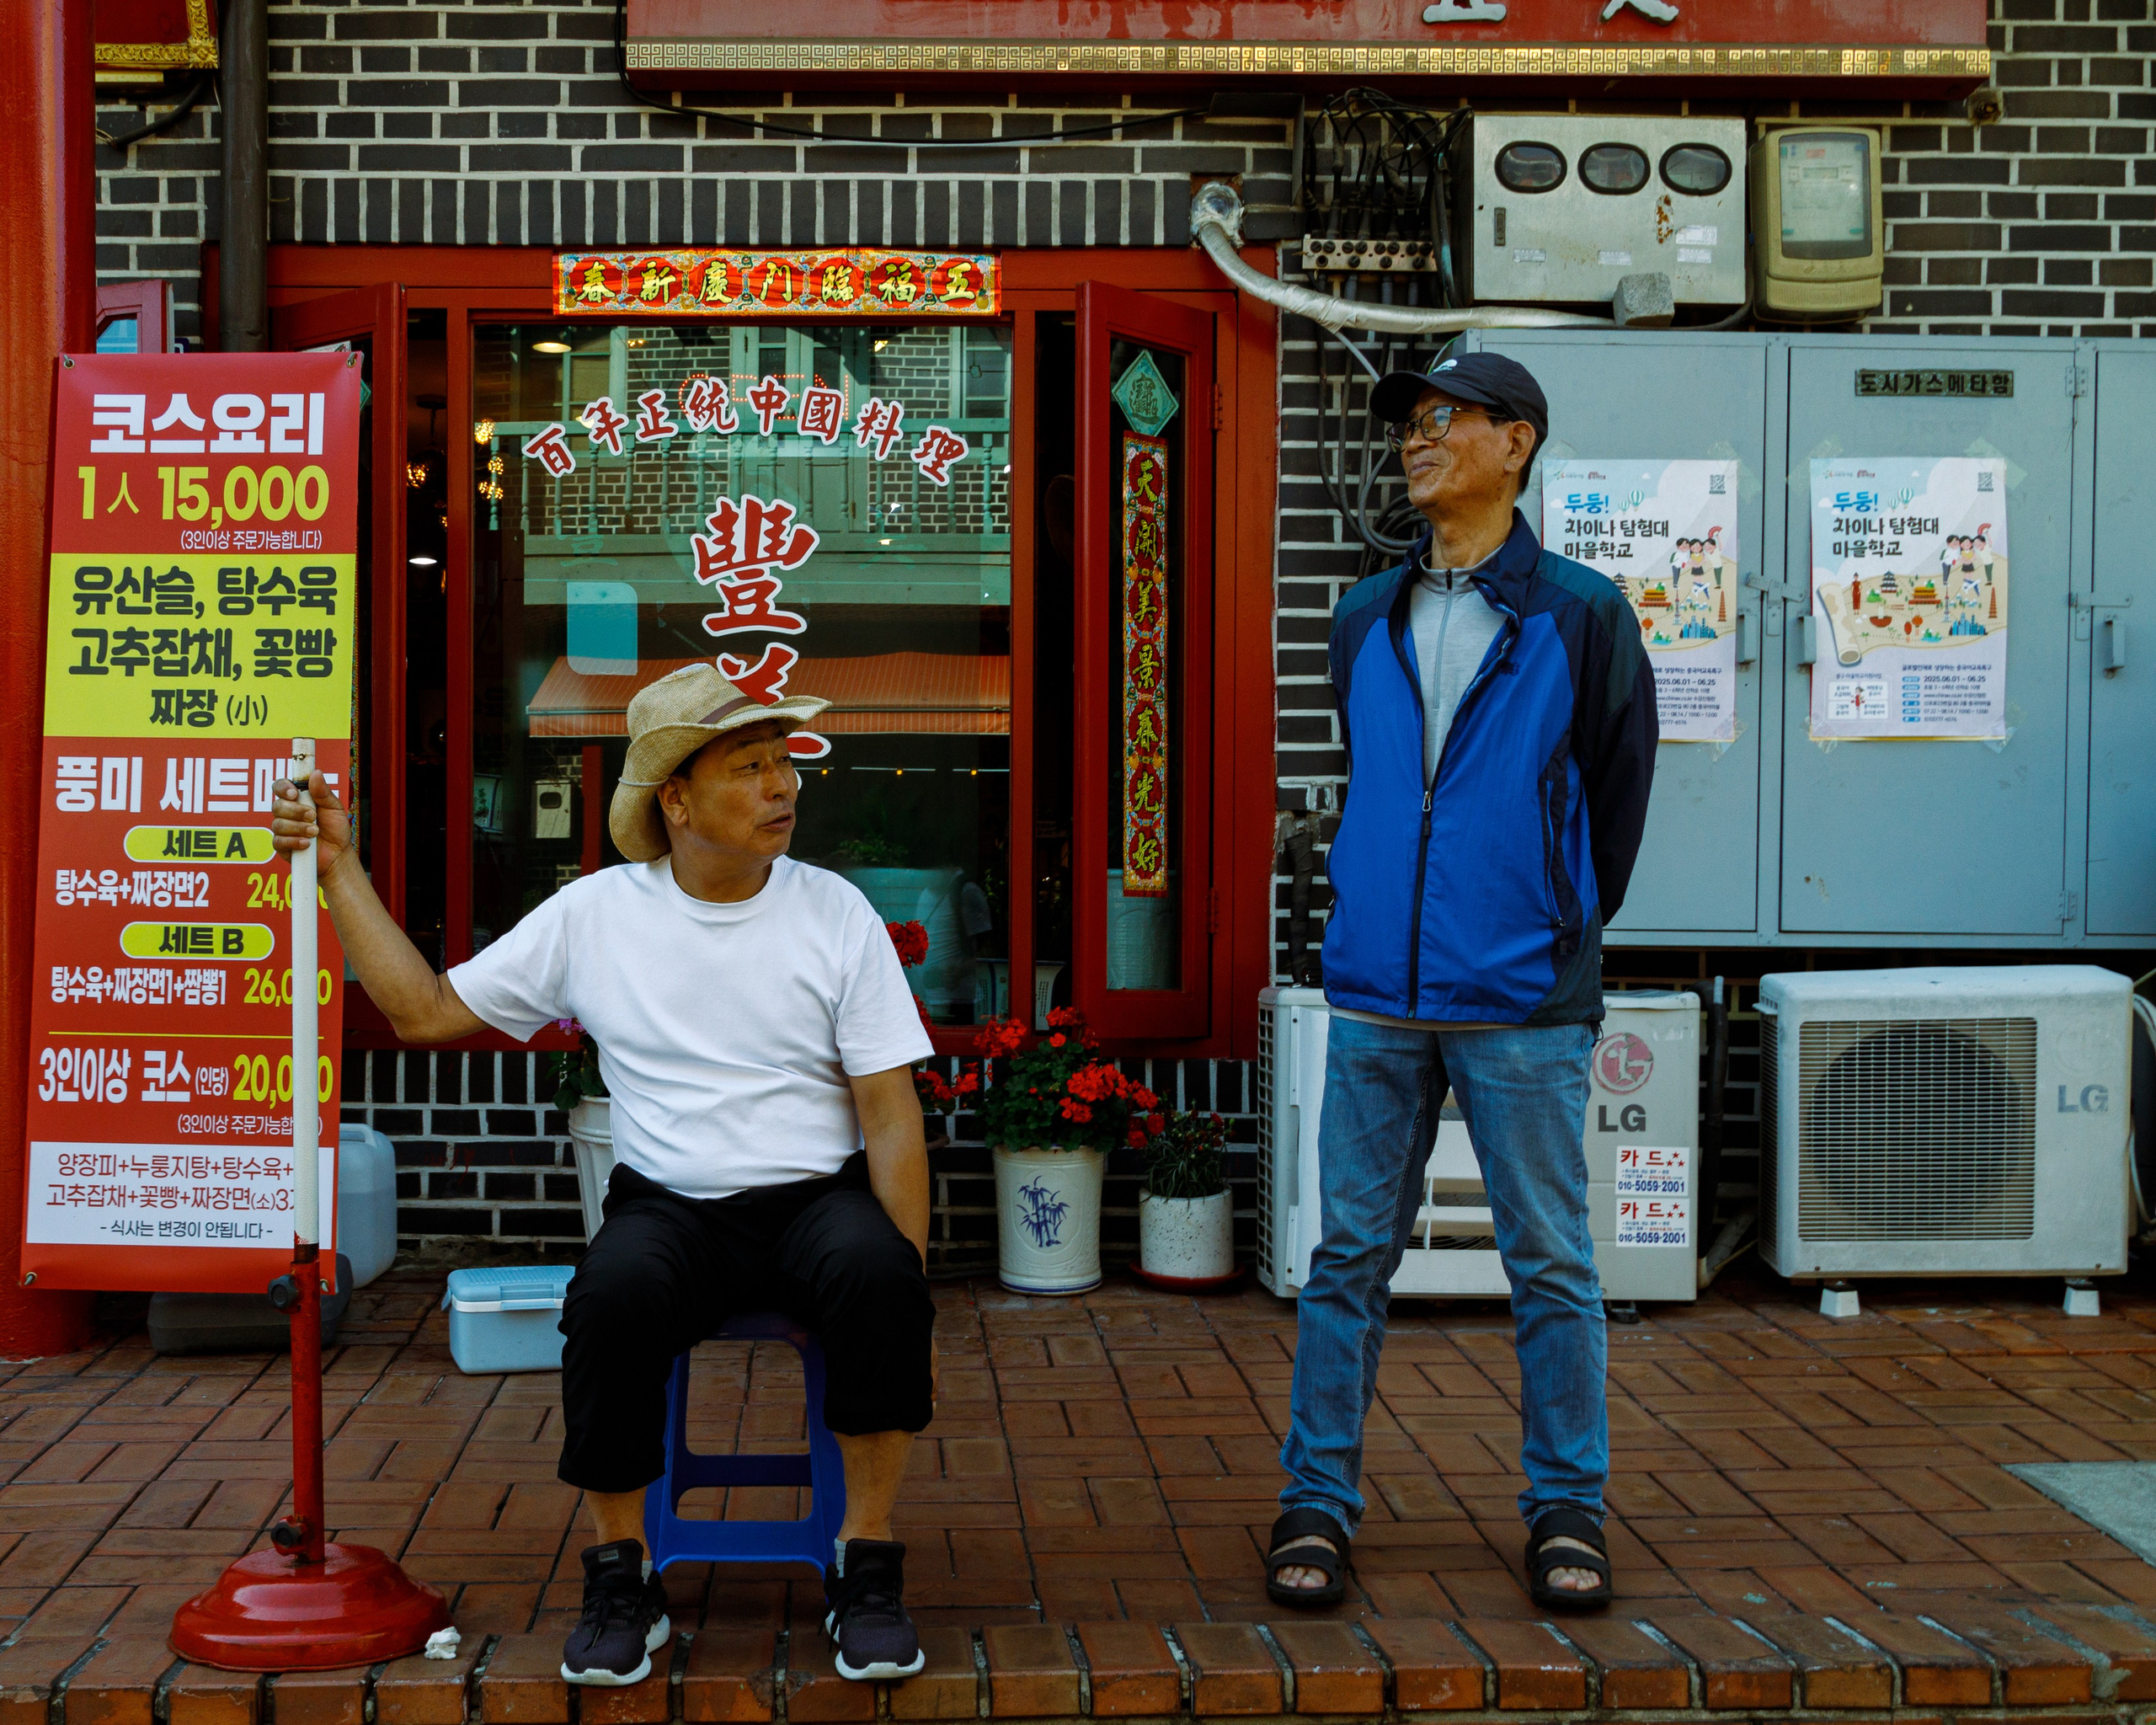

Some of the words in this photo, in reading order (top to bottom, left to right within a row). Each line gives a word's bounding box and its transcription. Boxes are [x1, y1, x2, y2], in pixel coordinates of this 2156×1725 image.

[1860, 373, 2009, 394] 도시가스메타함
[89, 393, 325, 456] 코스요리
[157, 465, 329, 530] 15,000
[1564, 493, 1609, 514] 두둥!
[1833, 490, 1878, 512] 두둥!
[1564, 518, 1615, 537] 차이나
[1620, 518, 1669, 537] 탐험대
[1833, 517, 1884, 536] 차이나
[1889, 516, 1940, 535] 탐험대
[180, 530, 229, 550] (3인이상
[232, 530, 322, 550] 주문가능합니다)
[1564, 542, 1634, 559] 마을학교
[1833, 539, 1903, 558] 마을학교
[72, 565, 205, 619] 유산슬,
[218, 565, 337, 616] 탕수육
[68, 627, 242, 681] 고추잡채,
[253, 628, 337, 678] 꽃빵
[150, 689, 217, 727] 짜장
[226, 694, 268, 726] (小)
[56, 756, 142, 813] 풍미
[159, 757, 339, 814] 세트메
[163, 830, 217, 858] 세트
[225, 832, 247, 858] A
[56, 869, 209, 908] 탕수육+짜장면2
[158, 926, 214, 955] 세트
[222, 927, 244, 954] B
[243, 968, 333, 1007] 26,00
[38, 1048, 131, 1103] 3인이상
[232, 1054, 334, 1109] 20,00
[2057, 1084, 2109, 1113] LG
[178, 1114, 228, 1135] (3인이상
[231, 1114, 323, 1136] 주문가능합)
[1598, 1104, 1646, 1133] LG
[46, 1184, 295, 1211] 고추잡채+꽃빵+짜장면(소)3
[1618, 1180, 1684, 1193] 010-5059-2001
[110, 1220, 154, 1237] 식사는
[158, 1221, 201, 1238] 변경이
[205, 1222, 263, 1239] 안됩니다
[1619, 1232, 1685, 1244] 010-5059-2001
